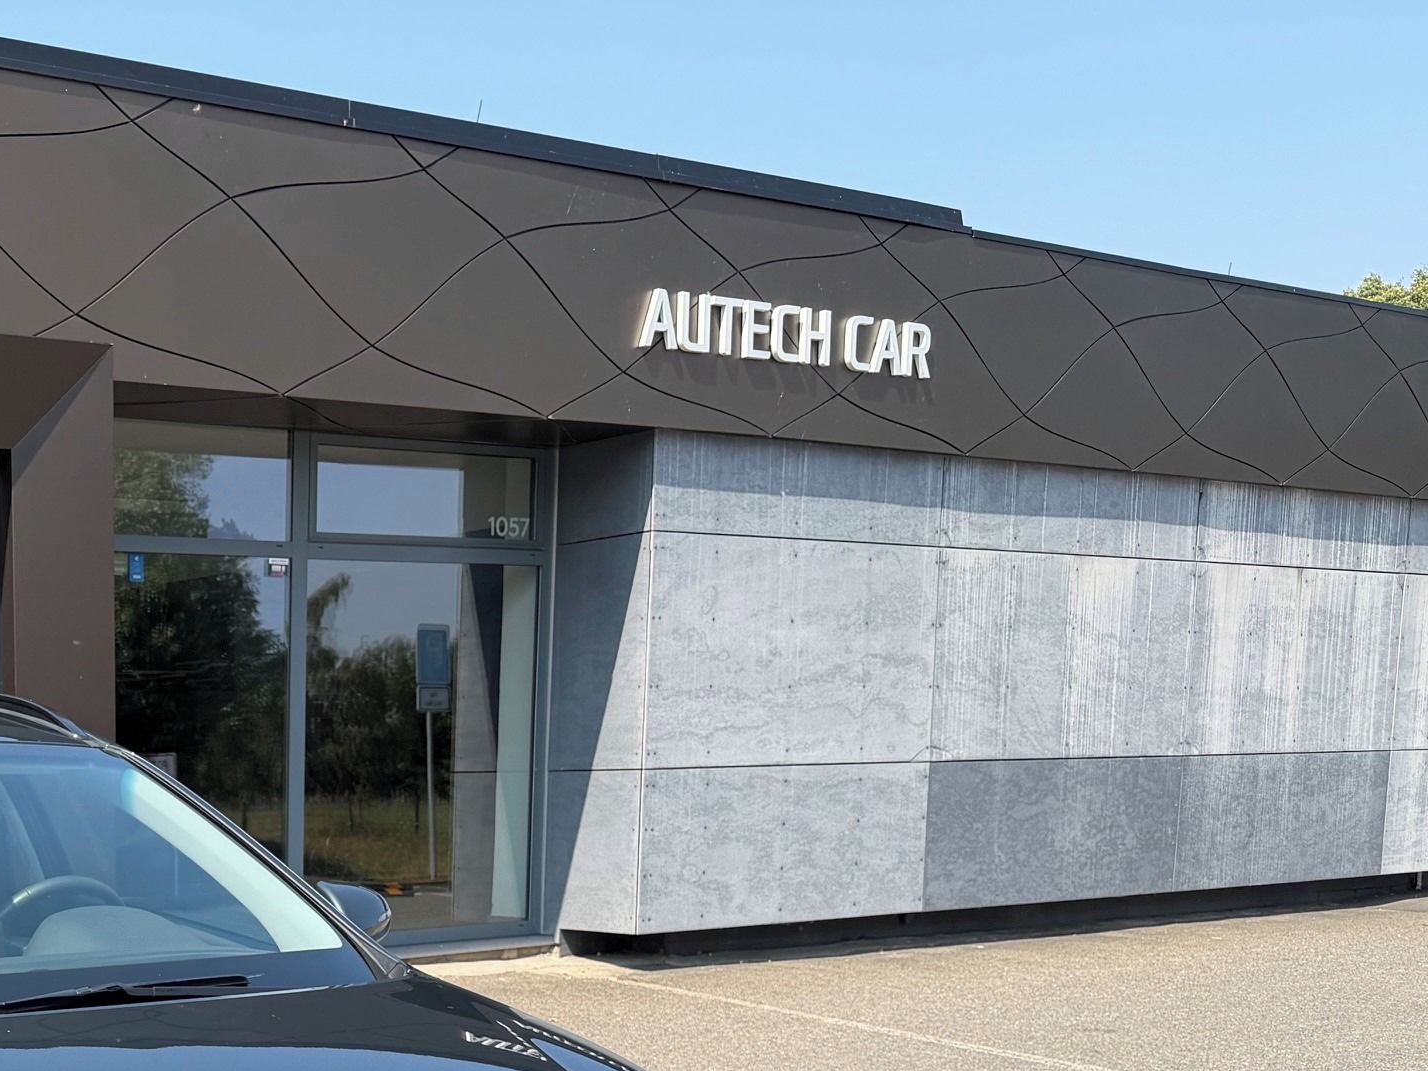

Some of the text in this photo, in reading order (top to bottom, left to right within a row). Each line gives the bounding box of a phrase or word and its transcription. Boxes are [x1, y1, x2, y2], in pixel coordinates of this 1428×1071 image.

[638, 288, 932, 379] AUTECH CAR
[487, 516, 530, 538] 1057
